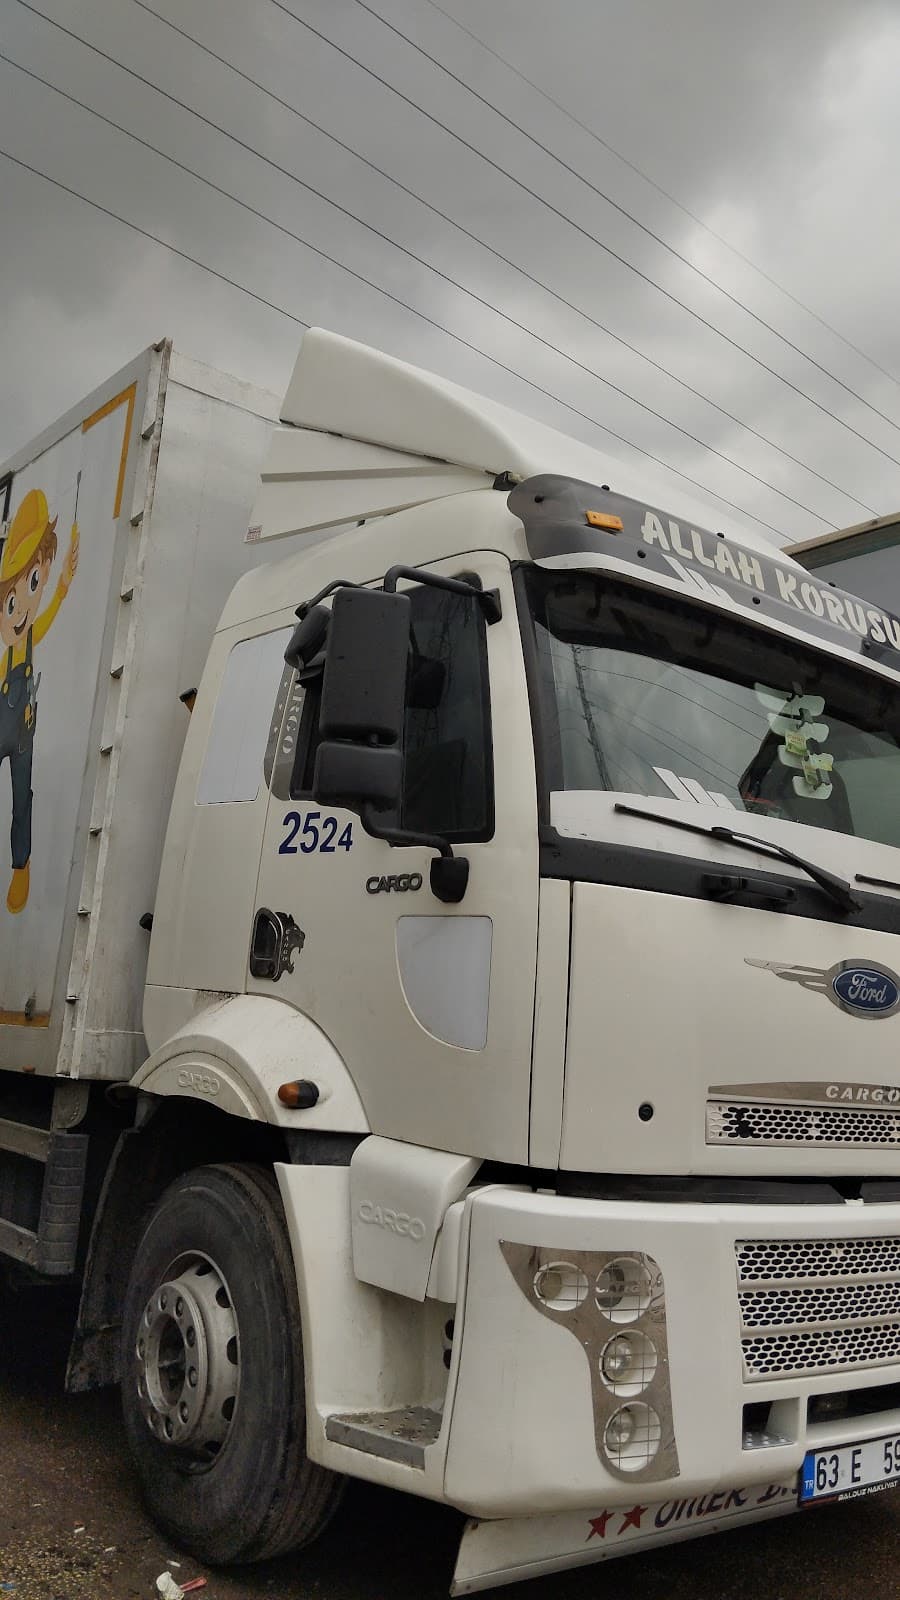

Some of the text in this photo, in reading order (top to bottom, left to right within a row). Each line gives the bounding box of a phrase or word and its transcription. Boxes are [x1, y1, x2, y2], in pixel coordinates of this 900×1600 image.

[641, 511, 765, 591] ALLAH
[278, 811, 353, 854] 2524
[365, 873, 423, 894] CARGO
[848, 973, 887, 1003] Ford
[825, 1085, 900, 1102] CARGO
[359, 1200, 426, 1240] CARGO
[804, 1479, 814, 1490] TR
[816, 1454, 839, 1491] 63
[851, 1448, 862, 1483] E
